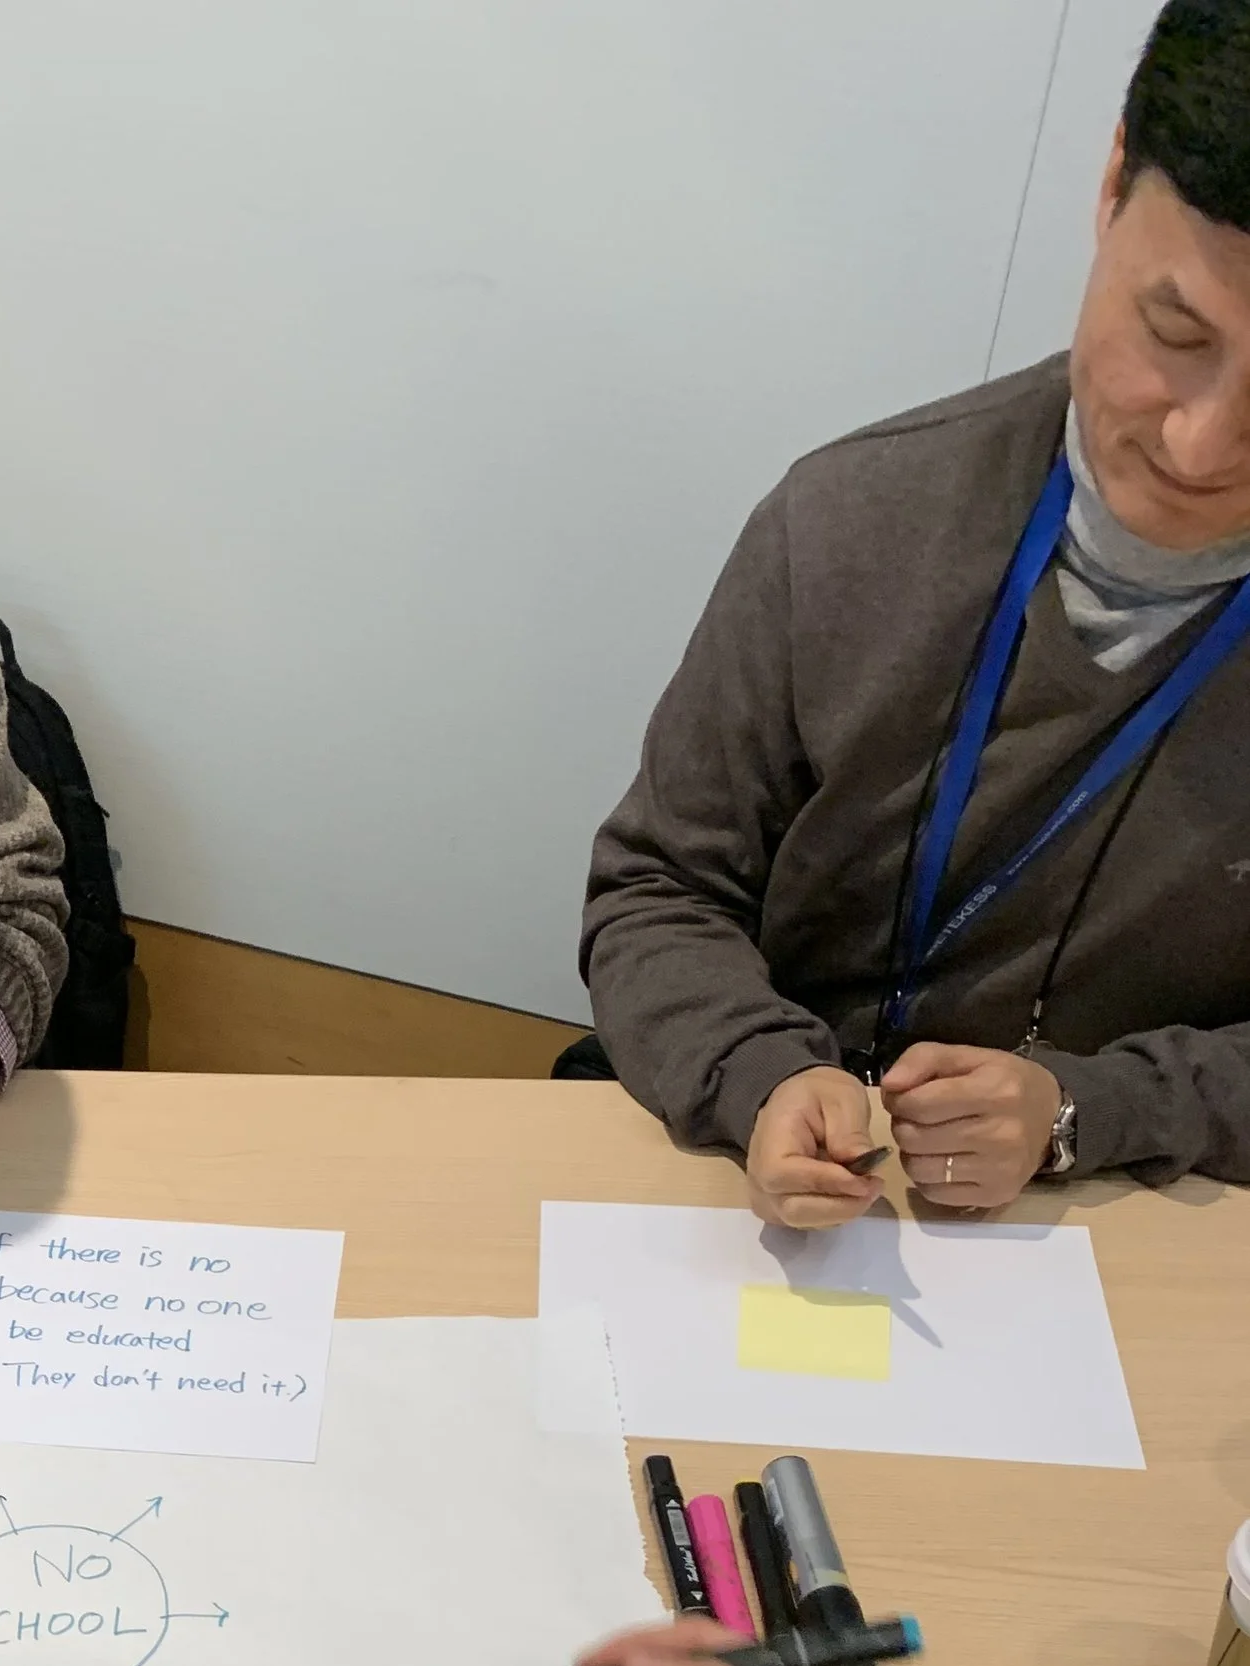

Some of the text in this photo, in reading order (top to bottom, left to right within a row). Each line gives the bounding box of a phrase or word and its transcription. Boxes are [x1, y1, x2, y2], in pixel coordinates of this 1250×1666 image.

[39, 1236, 122, 1264] there
[138, 1245, 163, 1268] is
[188, 1255, 231, 1274] no
[143, 1295, 186, 1313] no
[196, 1299, 273, 1321] one
[8, 1318, 44, 1341] be
[65, 1324, 192, 1353] educated
[92, 1364, 164, 1391] don't
[176, 1371, 246, 1395] need
[31, 1543, 113, 1588] NO
